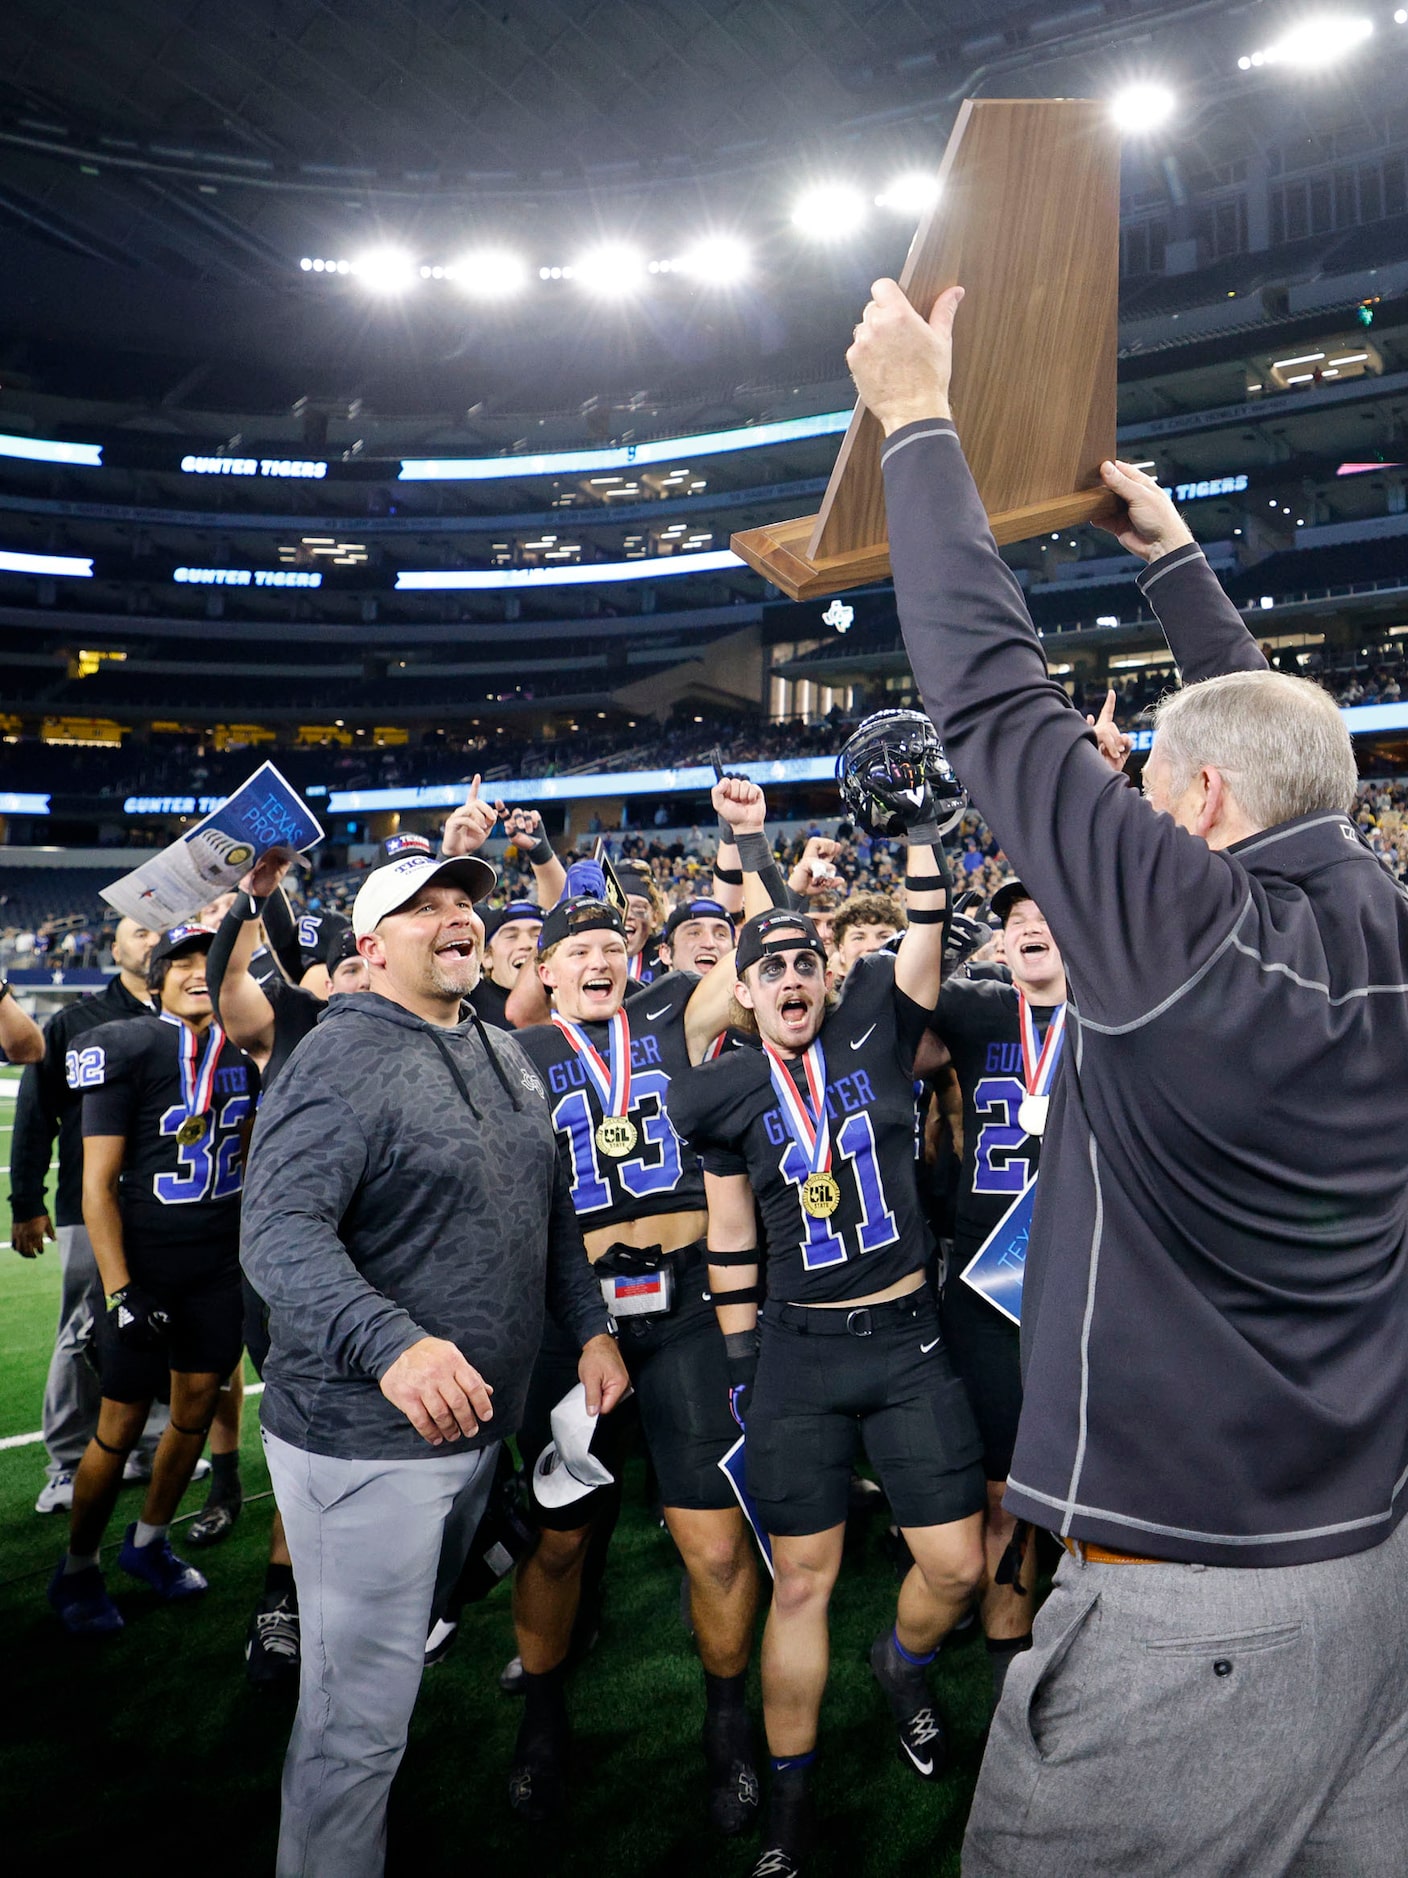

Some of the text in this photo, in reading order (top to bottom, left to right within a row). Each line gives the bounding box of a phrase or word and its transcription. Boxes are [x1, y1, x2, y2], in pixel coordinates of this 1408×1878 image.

[181, 455, 328, 479] GUNTER TIGERS
[1176, 474, 1249, 501] TIGERS
[173, 567, 322, 588] GUNTER TIGERS
[124, 796, 197, 814] GUNTER
[261, 793, 304, 845] TEXAS
[298, 915, 323, 948] 5
[65, 1046, 106, 1089] 32
[153, 1095, 250, 1205] 32
[552, 1069, 688, 1216] 13
[605, 1127, 629, 1143] UIL
[778, 1111, 901, 1272] 11
[810, 1185, 832, 1202] UIL
